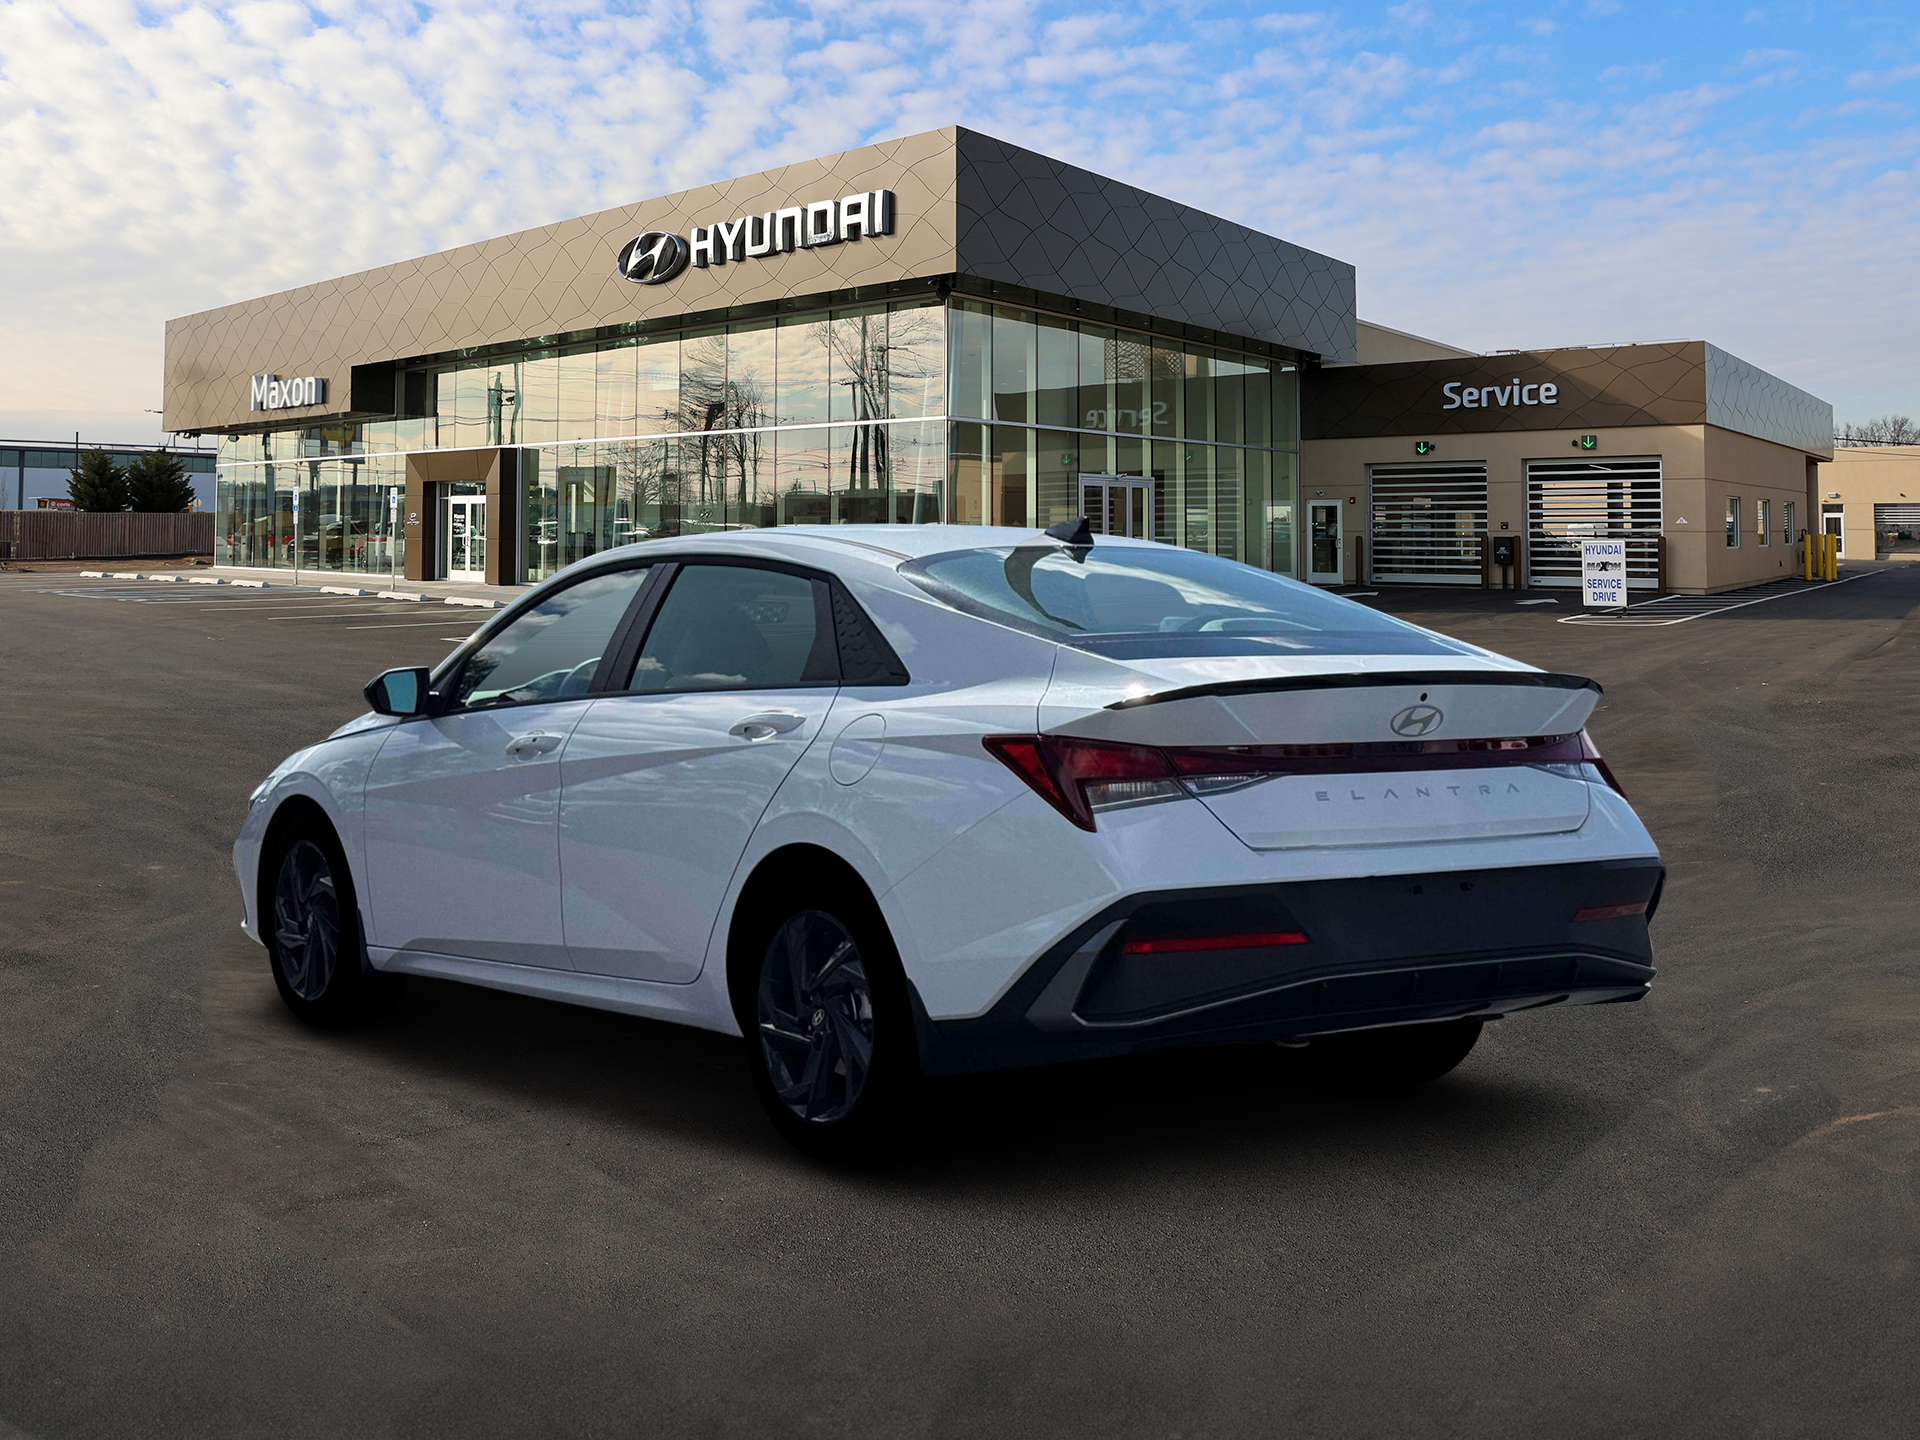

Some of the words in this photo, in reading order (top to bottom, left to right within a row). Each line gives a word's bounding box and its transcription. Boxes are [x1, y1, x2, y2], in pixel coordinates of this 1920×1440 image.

[690, 189, 892, 267] HYUNDAI
[250, 374, 319, 411] Maxon
[1443, 378, 1558, 409] Service
[1585, 544, 1622, 555] HYUNDAI
[1586, 561, 1622, 572] MAXON
[1586, 578, 1622, 589] SERVICE
[1592, 591, 1617, 602] DRIVE
[1315, 783, 1520, 801] ELANTRA
